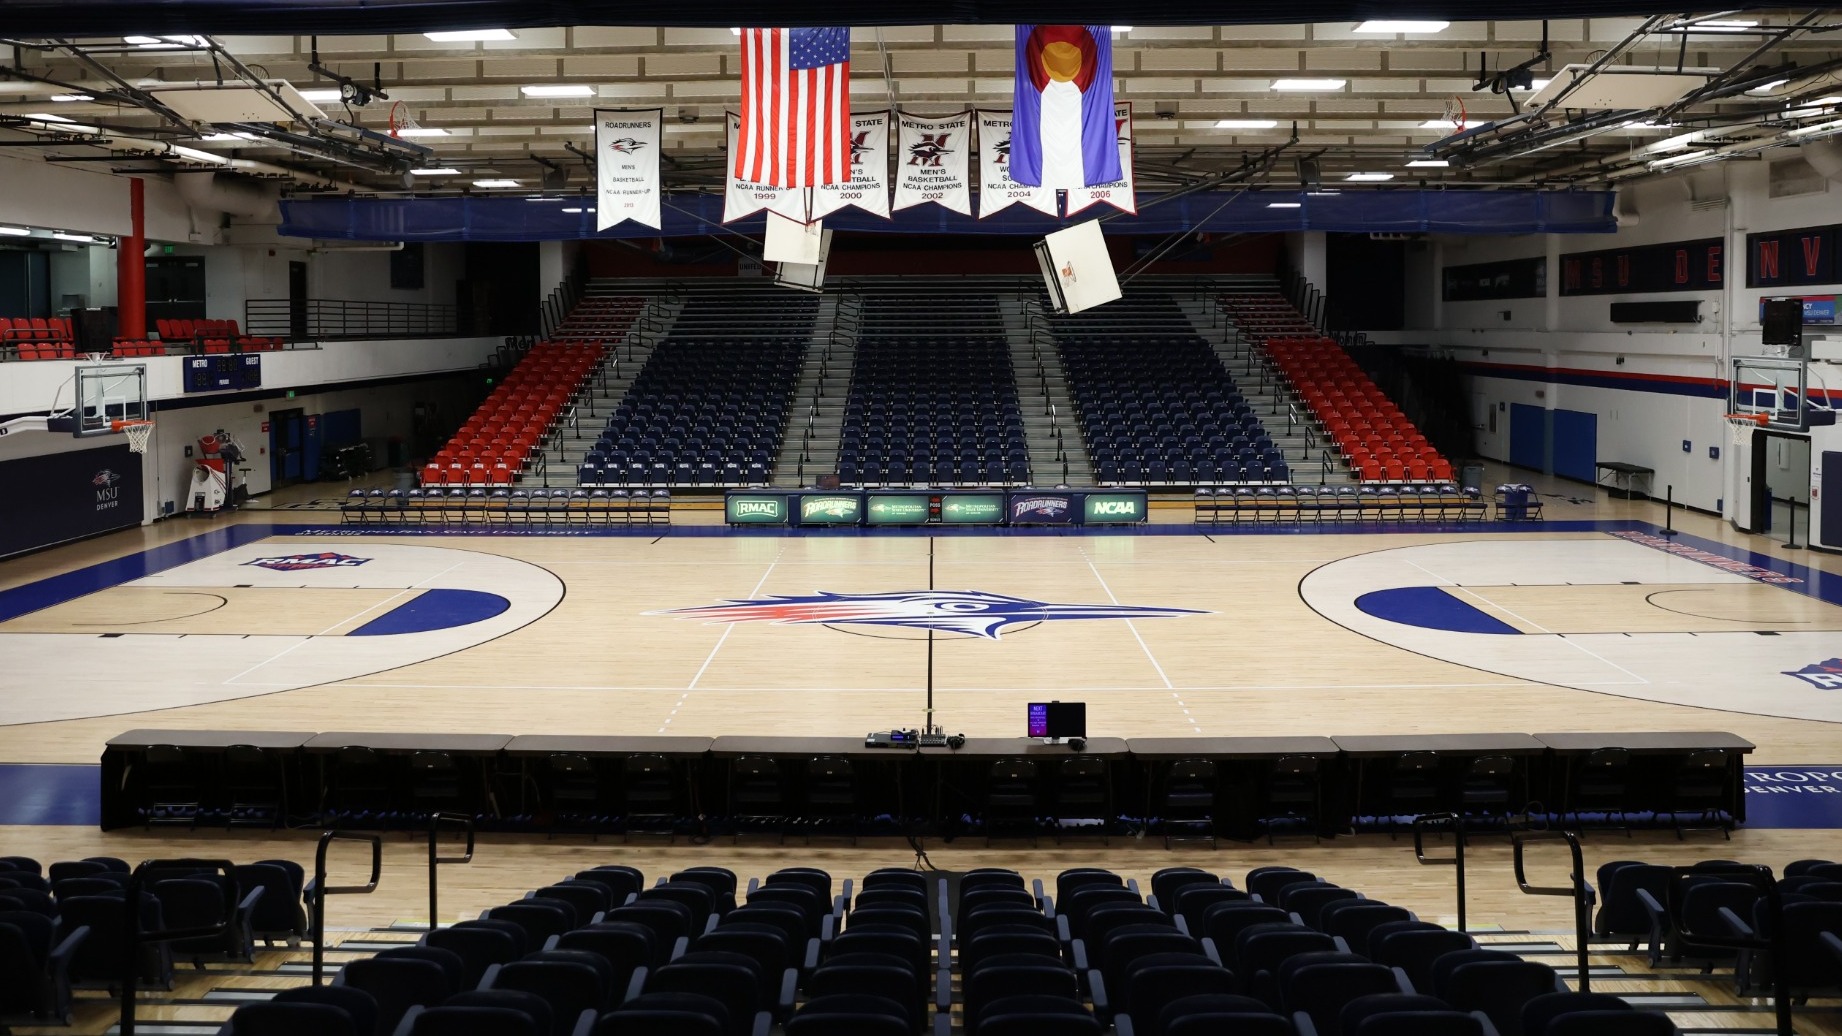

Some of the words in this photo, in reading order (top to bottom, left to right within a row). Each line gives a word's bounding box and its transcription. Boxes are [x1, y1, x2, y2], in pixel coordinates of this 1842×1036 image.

[605, 121, 652, 129] ROADRUNNERS
[855, 119, 883, 127] STATE
[901, 121, 934, 130] METRO
[938, 120, 966, 129] STATE
[820, 183, 840, 191] NCAA
[841, 183, 881, 191] CHAMPIONS
[922, 182, 962, 191] CHAMPIONS
[921, 192, 944, 200] 2002
[1090, 190, 1111, 199] 2006
[1567, 255, 1629, 290] MSU
[192, 359, 208, 368] METRO
[245, 357, 259, 366] GUEST
[96, 486, 118, 502] MSU
[96, 501, 118, 511] DENVER
[740, 503, 775, 514] RMAC
[803, 499, 857, 517] ROADRUNNERS
[1014, 499, 1068, 517] ROADRUNNERS
[1094, 501, 1137, 514] NCAA
[251, 558, 367, 566] RMAC
